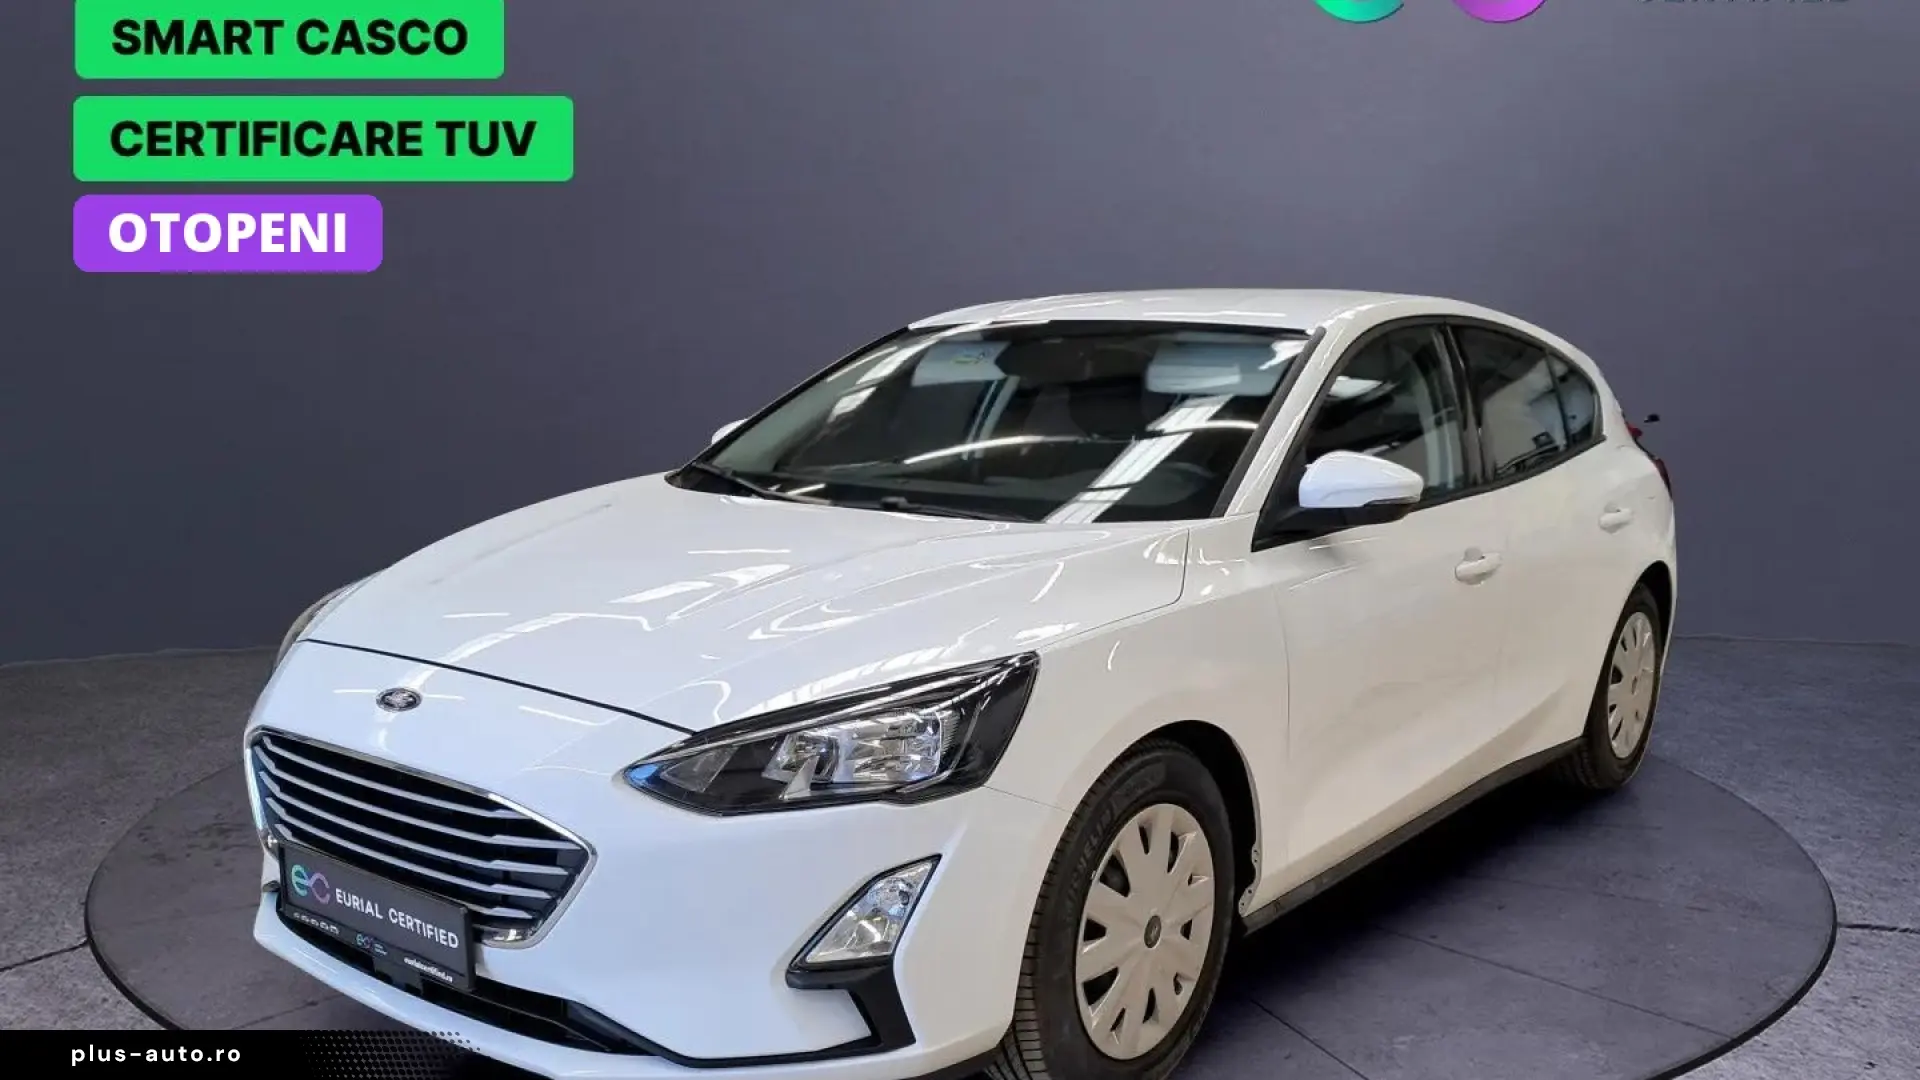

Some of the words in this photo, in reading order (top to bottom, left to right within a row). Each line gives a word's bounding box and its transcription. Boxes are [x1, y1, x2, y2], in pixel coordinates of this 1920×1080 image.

[1065, 809, 1112, 923] MICHELIN
[336, 887, 384, 920] EURIAL
[388, 907, 460, 949] CERTIFIED
